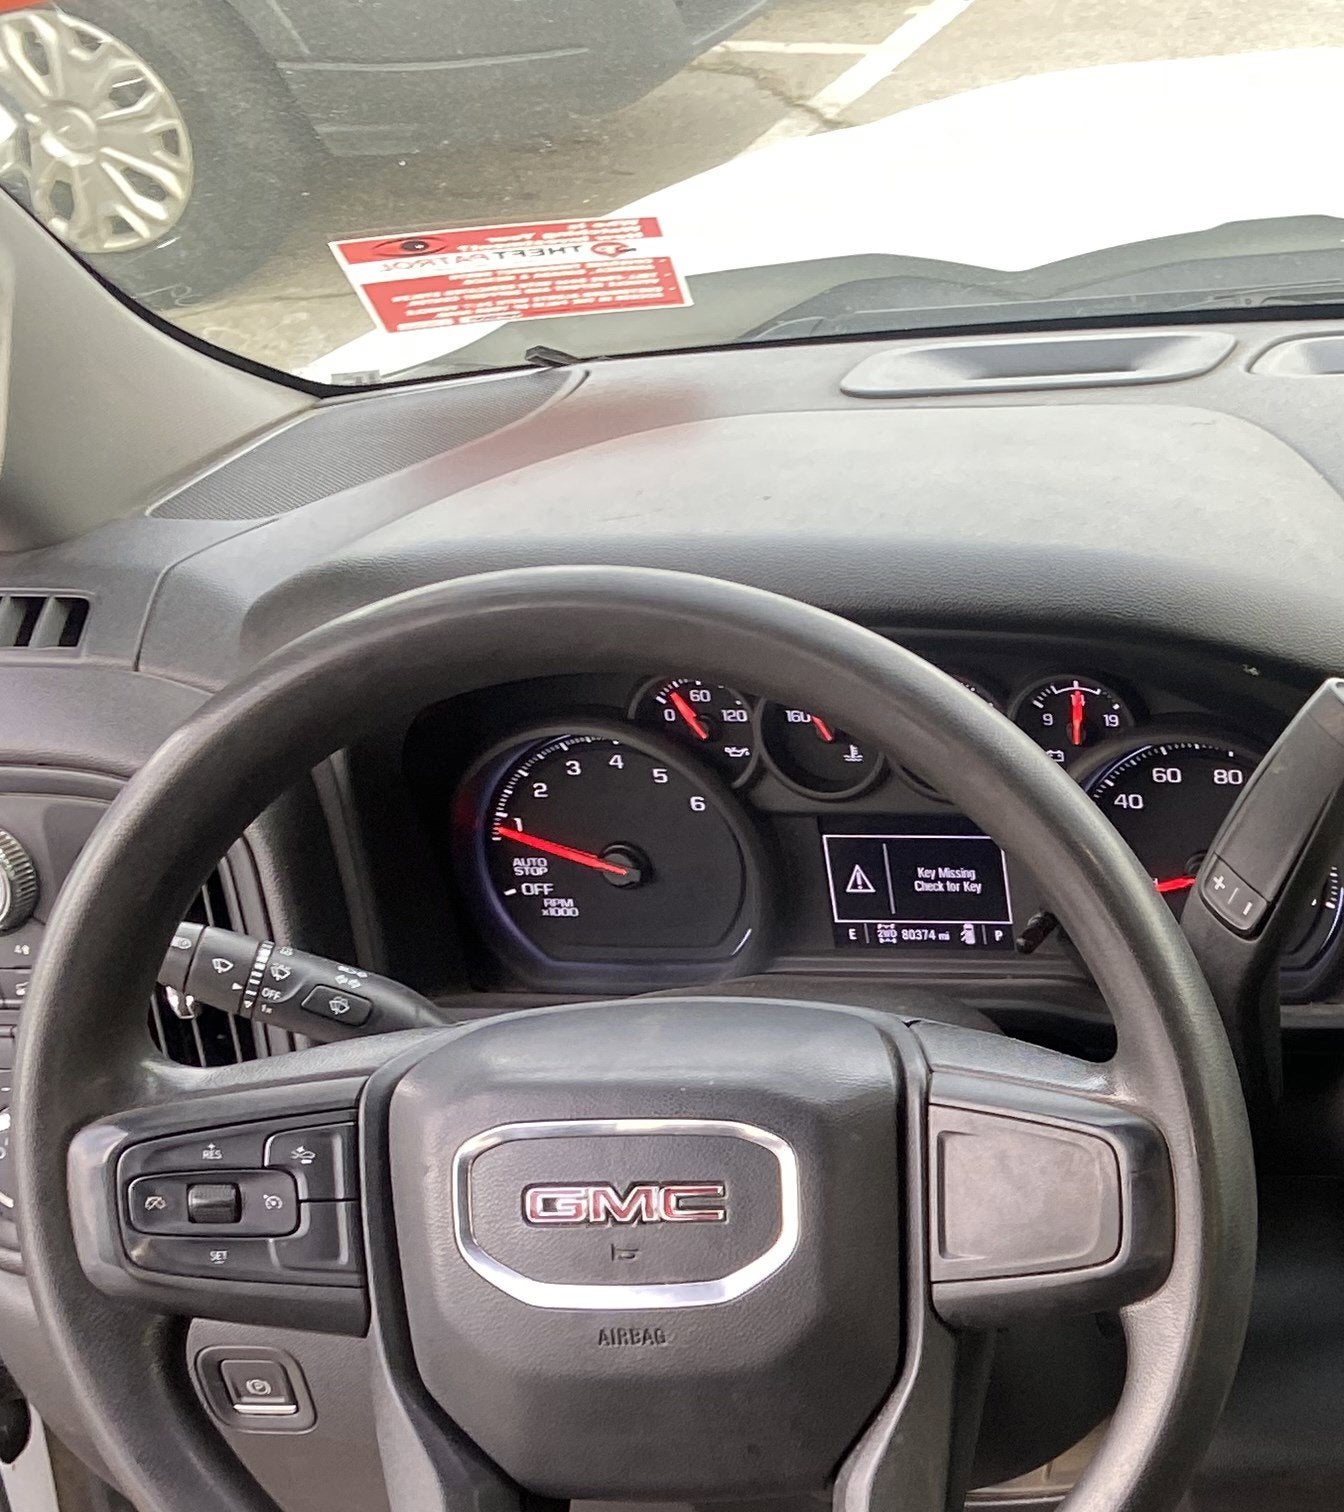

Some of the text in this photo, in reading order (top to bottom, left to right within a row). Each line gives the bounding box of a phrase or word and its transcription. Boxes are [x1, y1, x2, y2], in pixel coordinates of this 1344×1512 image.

[689, 689, 711, 703] 60
[664, 708, 676, 723] 0
[721, 709, 748, 723] 120
[1042, 713, 1053, 726] 9
[1102, 714, 1120, 727] 19
[566, 761, 581, 776] 3
[608, 754, 624, 769] 4
[652, 768, 668, 784] 5
[1152, 767, 1182, 783] 60
[1213, 769, 1243, 785] 80
[533, 782, 549, 798] 2
[690, 796, 706, 812] 6
[1114, 794, 1144, 809] 40
[513, 817, 524, 832] 1
[512, 858, 548, 867] AUTO
[514, 866, 548, 876] STOP
[916, 867, 976, 881] Key Missing
[521, 883, 554, 896] OFF
[914, 881, 982, 894] Check for Key
[543, 898, 574, 907] RPM
[542, 907, 579, 917] x1000
[901, 929, 936, 941] 80374
[994, 930, 1003, 942] P
[261, 987, 281, 1000] OFF
[525, 1185, 726, 1224] GMC
[597, 1327, 667, 1347] AIRBAG
